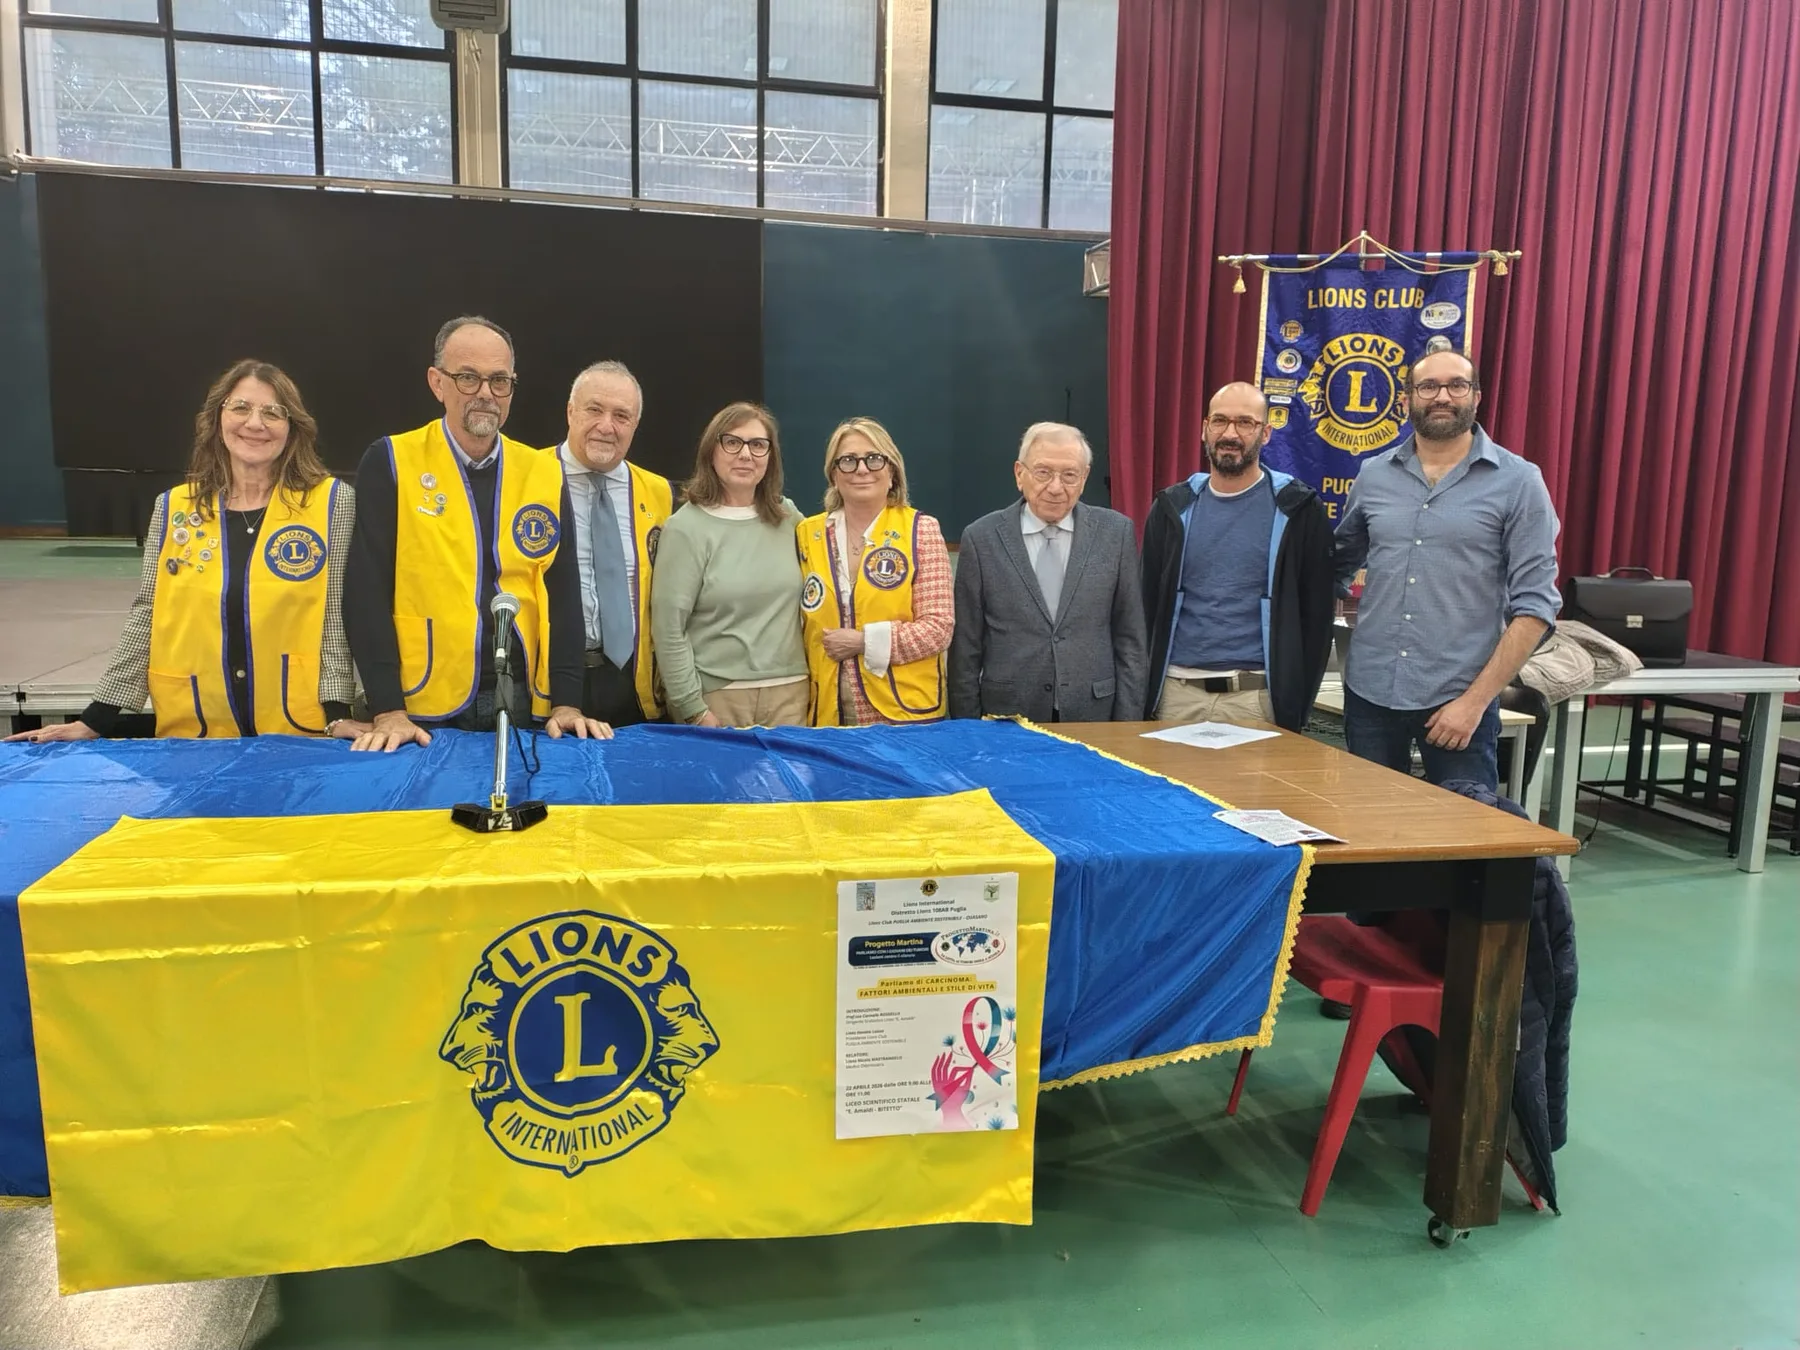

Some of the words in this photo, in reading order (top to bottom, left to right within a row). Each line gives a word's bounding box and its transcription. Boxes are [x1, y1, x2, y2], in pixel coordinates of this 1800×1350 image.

[1308, 287, 1367, 310] LIONS
[1374, 287, 1425, 310] CLUB
[1326, 336, 1400, 364] LIONS
[1344, 370, 1378, 412] L
[1322, 422, 1394, 446] INTERNATIONAL
[524, 510, 546, 520] LIONS
[280, 531, 311, 542] LIONS
[530, 522, 540, 538] L
[289, 542, 304, 560] L
[880, 560, 892, 574] L
[500, 922, 662, 978] LIONS
[554, 992, 618, 1082] L
[501, 1103, 654, 1156] INTERNATIONAL
